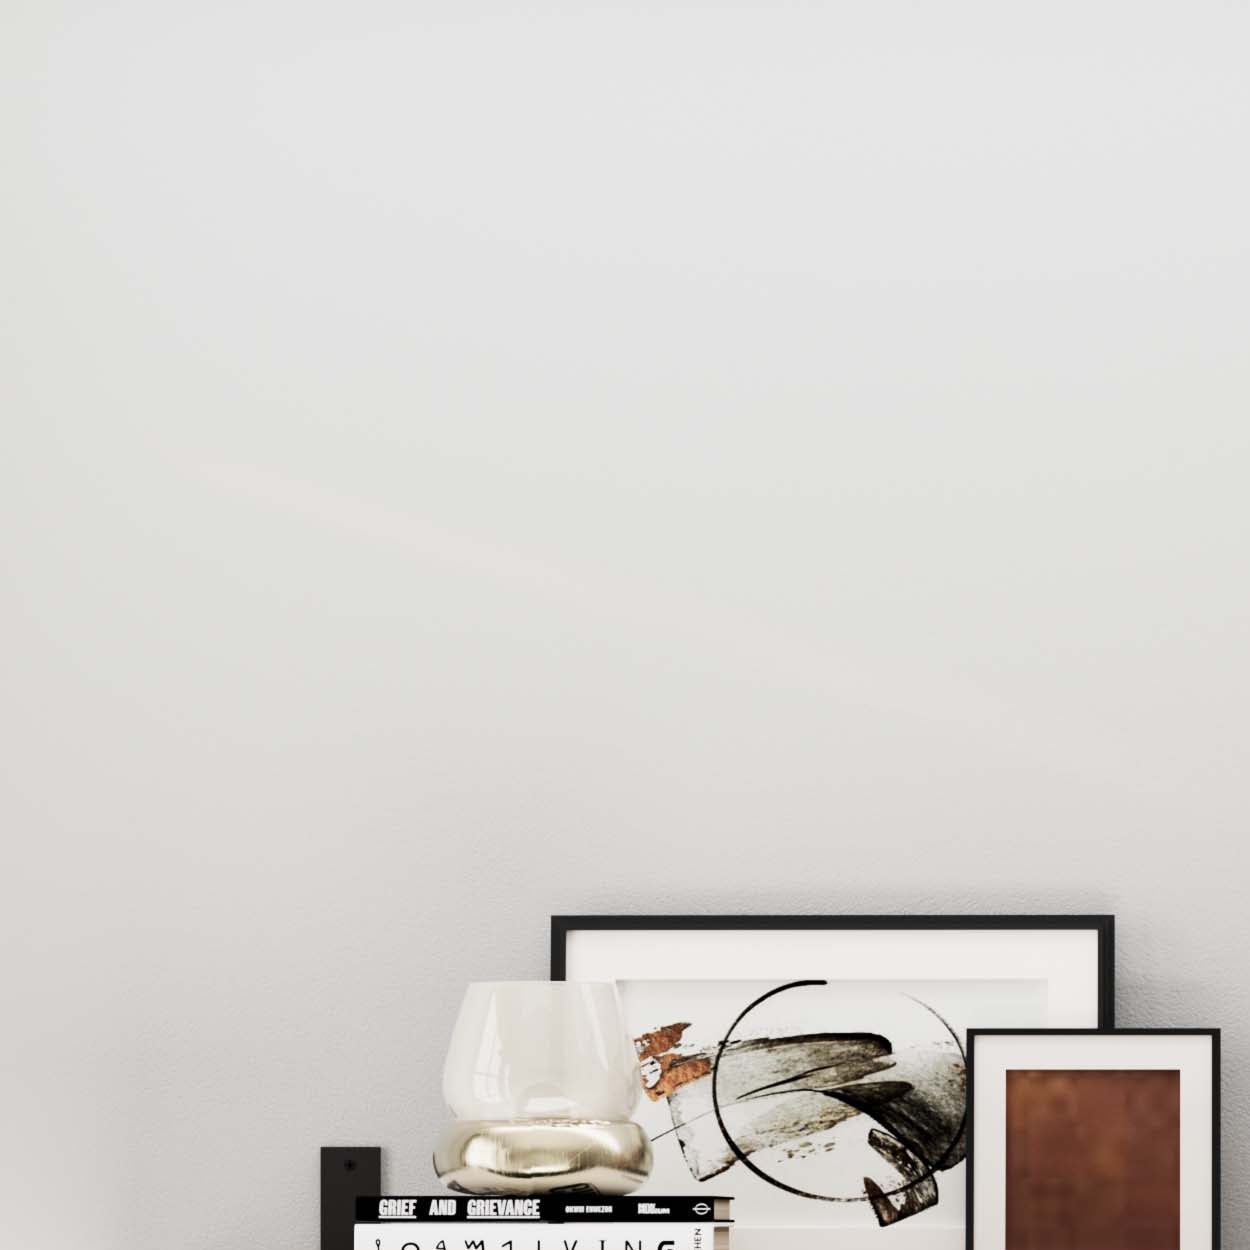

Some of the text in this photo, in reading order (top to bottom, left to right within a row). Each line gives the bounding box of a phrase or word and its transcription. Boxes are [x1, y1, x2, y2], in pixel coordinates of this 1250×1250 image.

[378, 1199, 541, 1217] GRIEF AND GRIEVANCE
